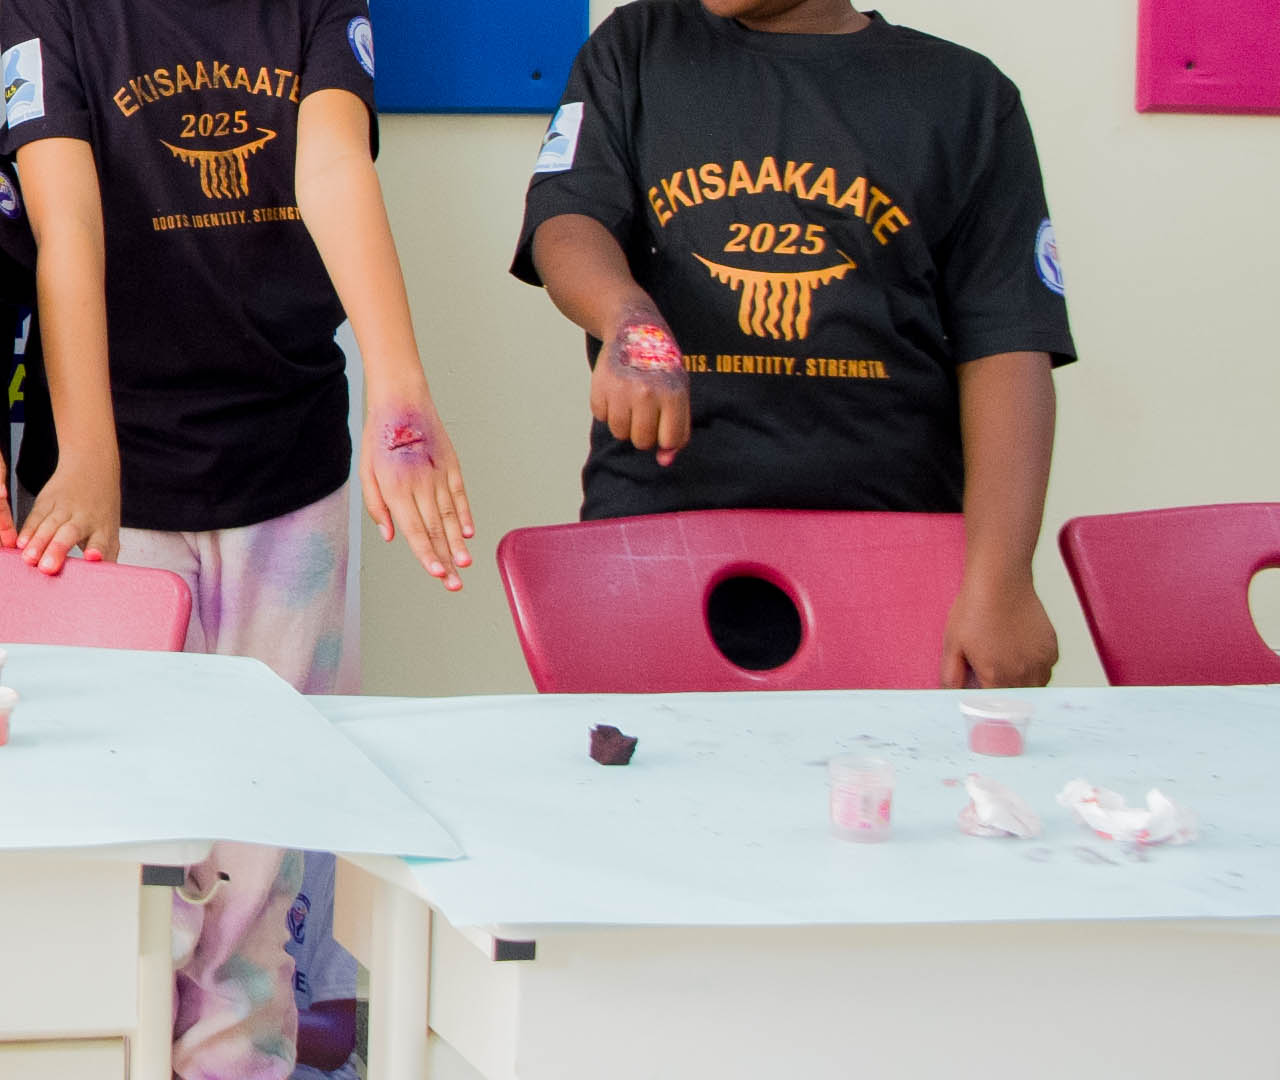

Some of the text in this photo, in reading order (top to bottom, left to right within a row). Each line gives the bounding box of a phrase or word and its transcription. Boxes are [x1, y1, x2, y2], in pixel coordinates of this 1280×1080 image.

[180, 109, 249, 138] 2025
[648, 155, 912, 247] EKISAAKAATE
[723, 222, 826, 255] 2025
[716, 354, 802, 376] IDENTITY.
